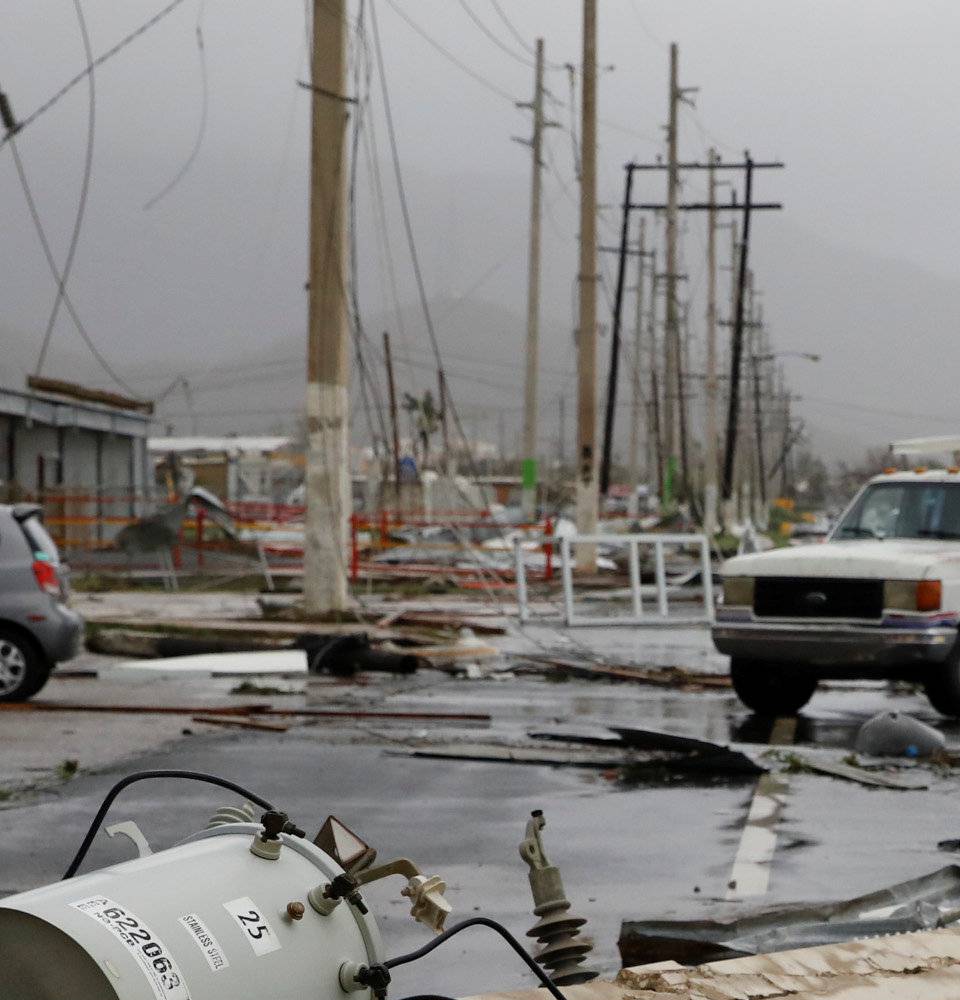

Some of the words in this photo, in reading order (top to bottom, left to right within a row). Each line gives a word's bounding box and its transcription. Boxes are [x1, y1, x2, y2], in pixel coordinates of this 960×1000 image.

[103, 907, 180, 990] 622063
[182, 915, 213, 948] STAINLESS
[207, 948, 224, 969] STEEL
[237, 910, 271, 939] 25
